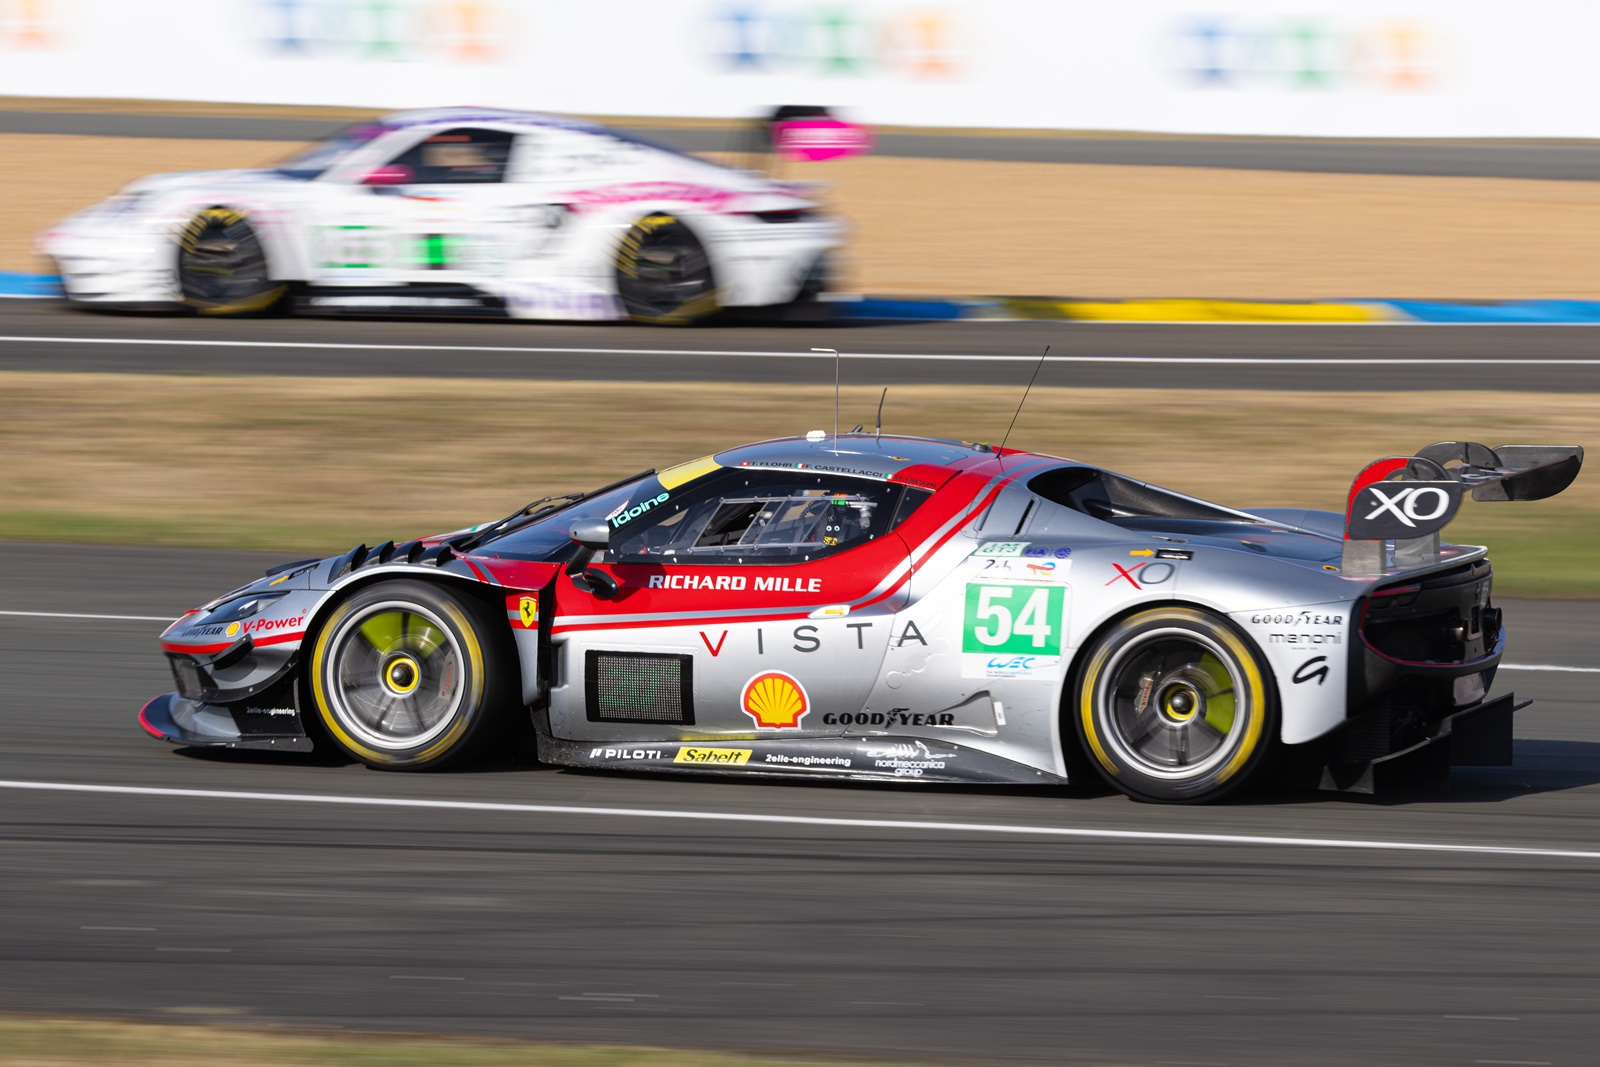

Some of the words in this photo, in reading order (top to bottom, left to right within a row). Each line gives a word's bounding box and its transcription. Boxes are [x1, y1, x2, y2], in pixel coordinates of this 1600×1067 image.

[814, 465, 883, 478] CASTELLACCI
[1364, 487, 1450, 528] XO
[649, 575, 747, 591] RICHARD
[754, 576, 823, 593] MILLE
[1105, 561, 1176, 591] XO
[242, 616, 305, 634] V-Power
[974, 586, 1052, 648] 54
[699, 620, 929, 657] VISTA
[987, 656, 1036, 669] WEC
[605, 748, 661, 760] PILOTI
[682, 748, 743, 764] Sabelt
[765, 754, 852, 768] 2elle-engineering
[875, 757, 946, 770] nordmeccanica
[894, 767, 924, 777] group
